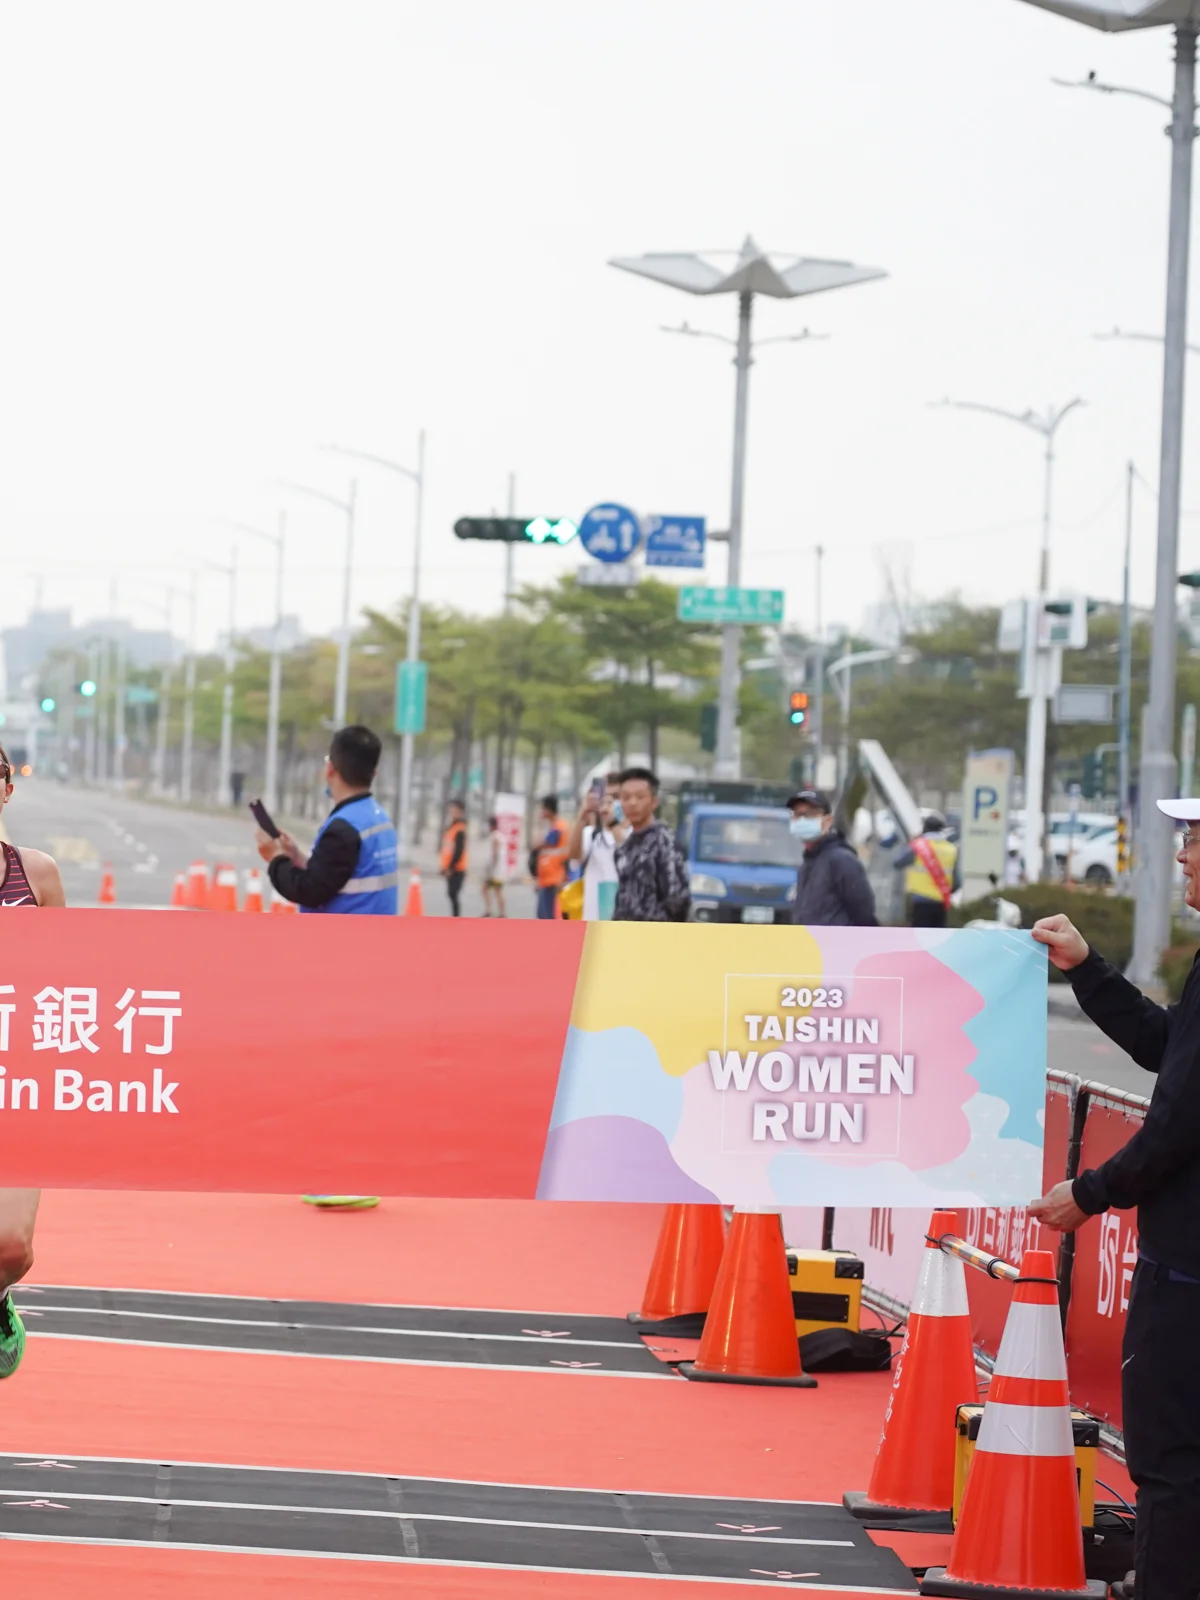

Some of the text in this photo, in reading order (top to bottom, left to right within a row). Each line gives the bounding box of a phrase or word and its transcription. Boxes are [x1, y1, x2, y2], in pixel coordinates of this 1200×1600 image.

[781, 987, 843, 1008] 2023
[744, 1015, 879, 1044] TAISHIN
[54, 1068, 180, 1114] Bank
[708, 1050, 914, 1095] WOMEN
[753, 1101, 864, 1143] RUN
